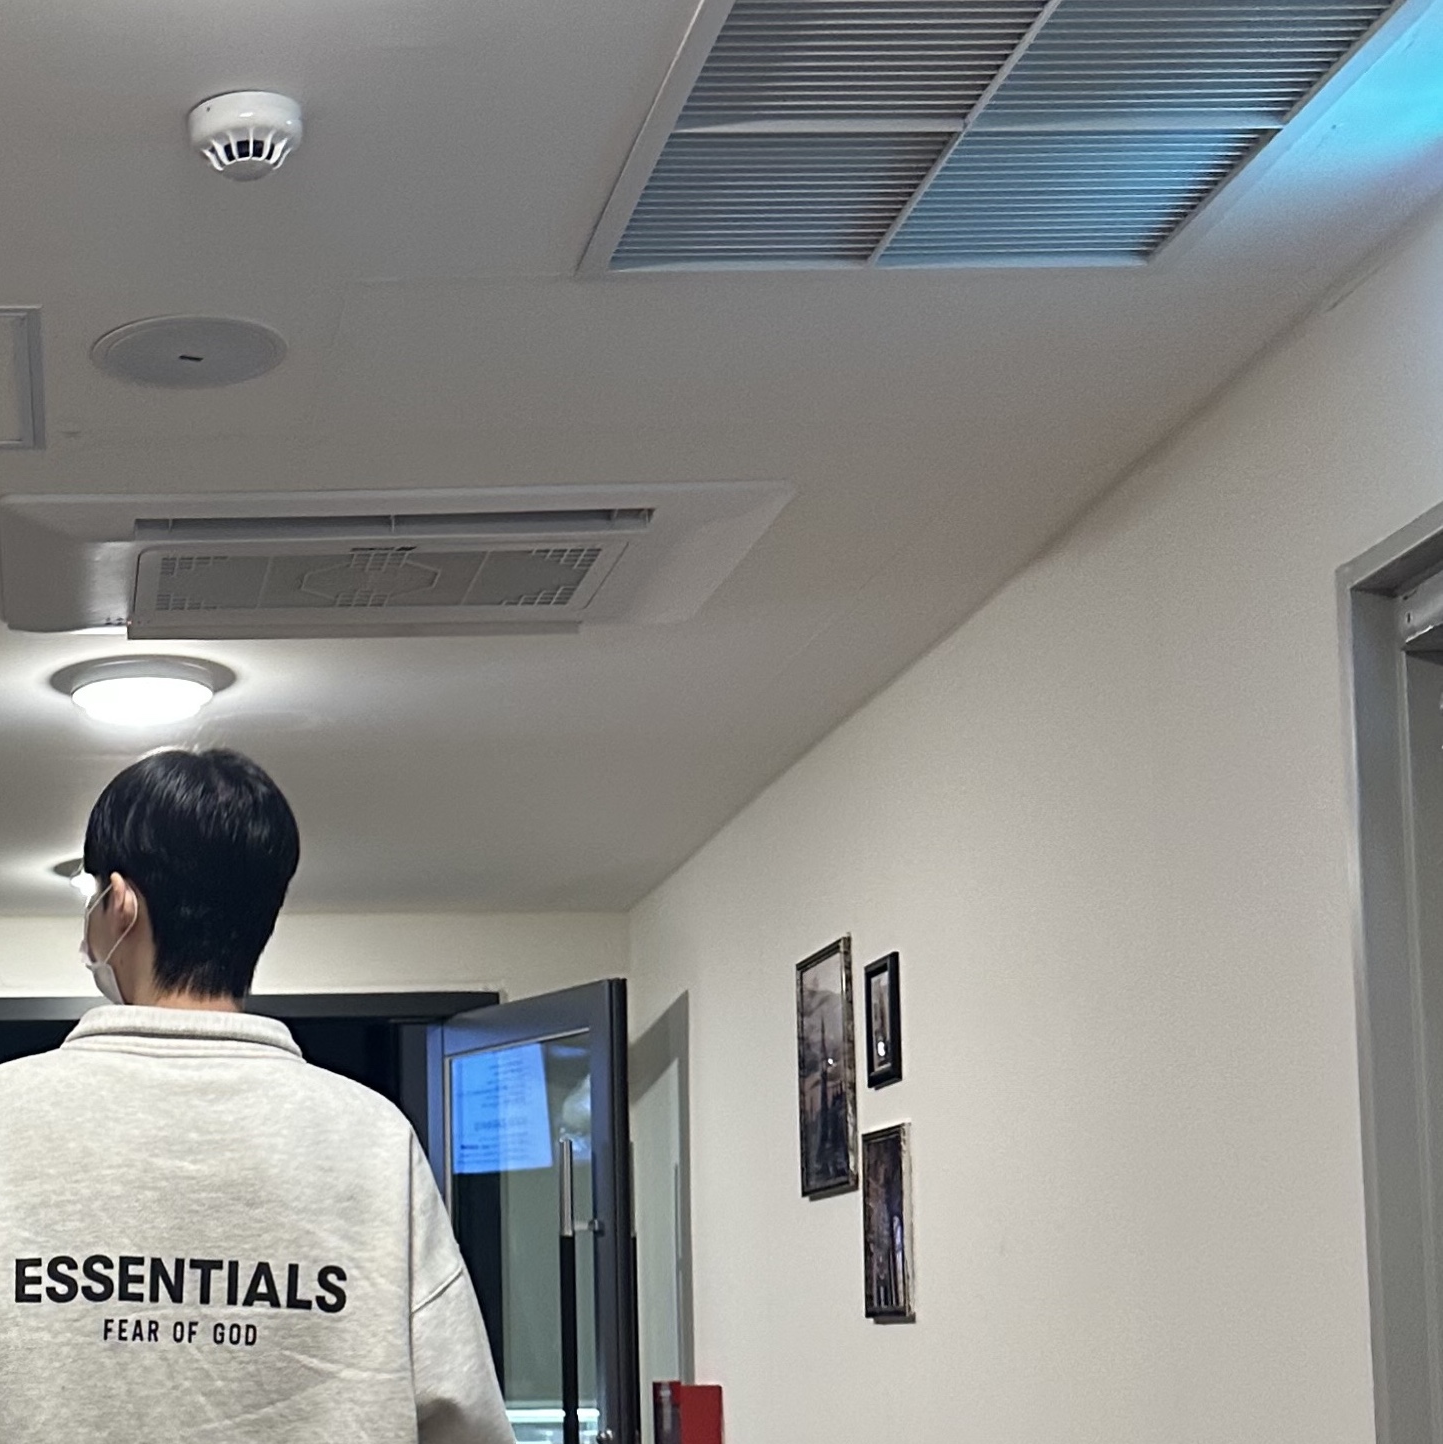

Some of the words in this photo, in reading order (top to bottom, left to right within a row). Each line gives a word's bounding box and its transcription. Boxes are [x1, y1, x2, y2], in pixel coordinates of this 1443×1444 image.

[15, 1255, 347, 1313] ESSENTIALS
[104, 1319, 159, 1342] FEAR
[173, 1321, 198, 1343] OF
[213, 1323, 256, 1346] GOD
